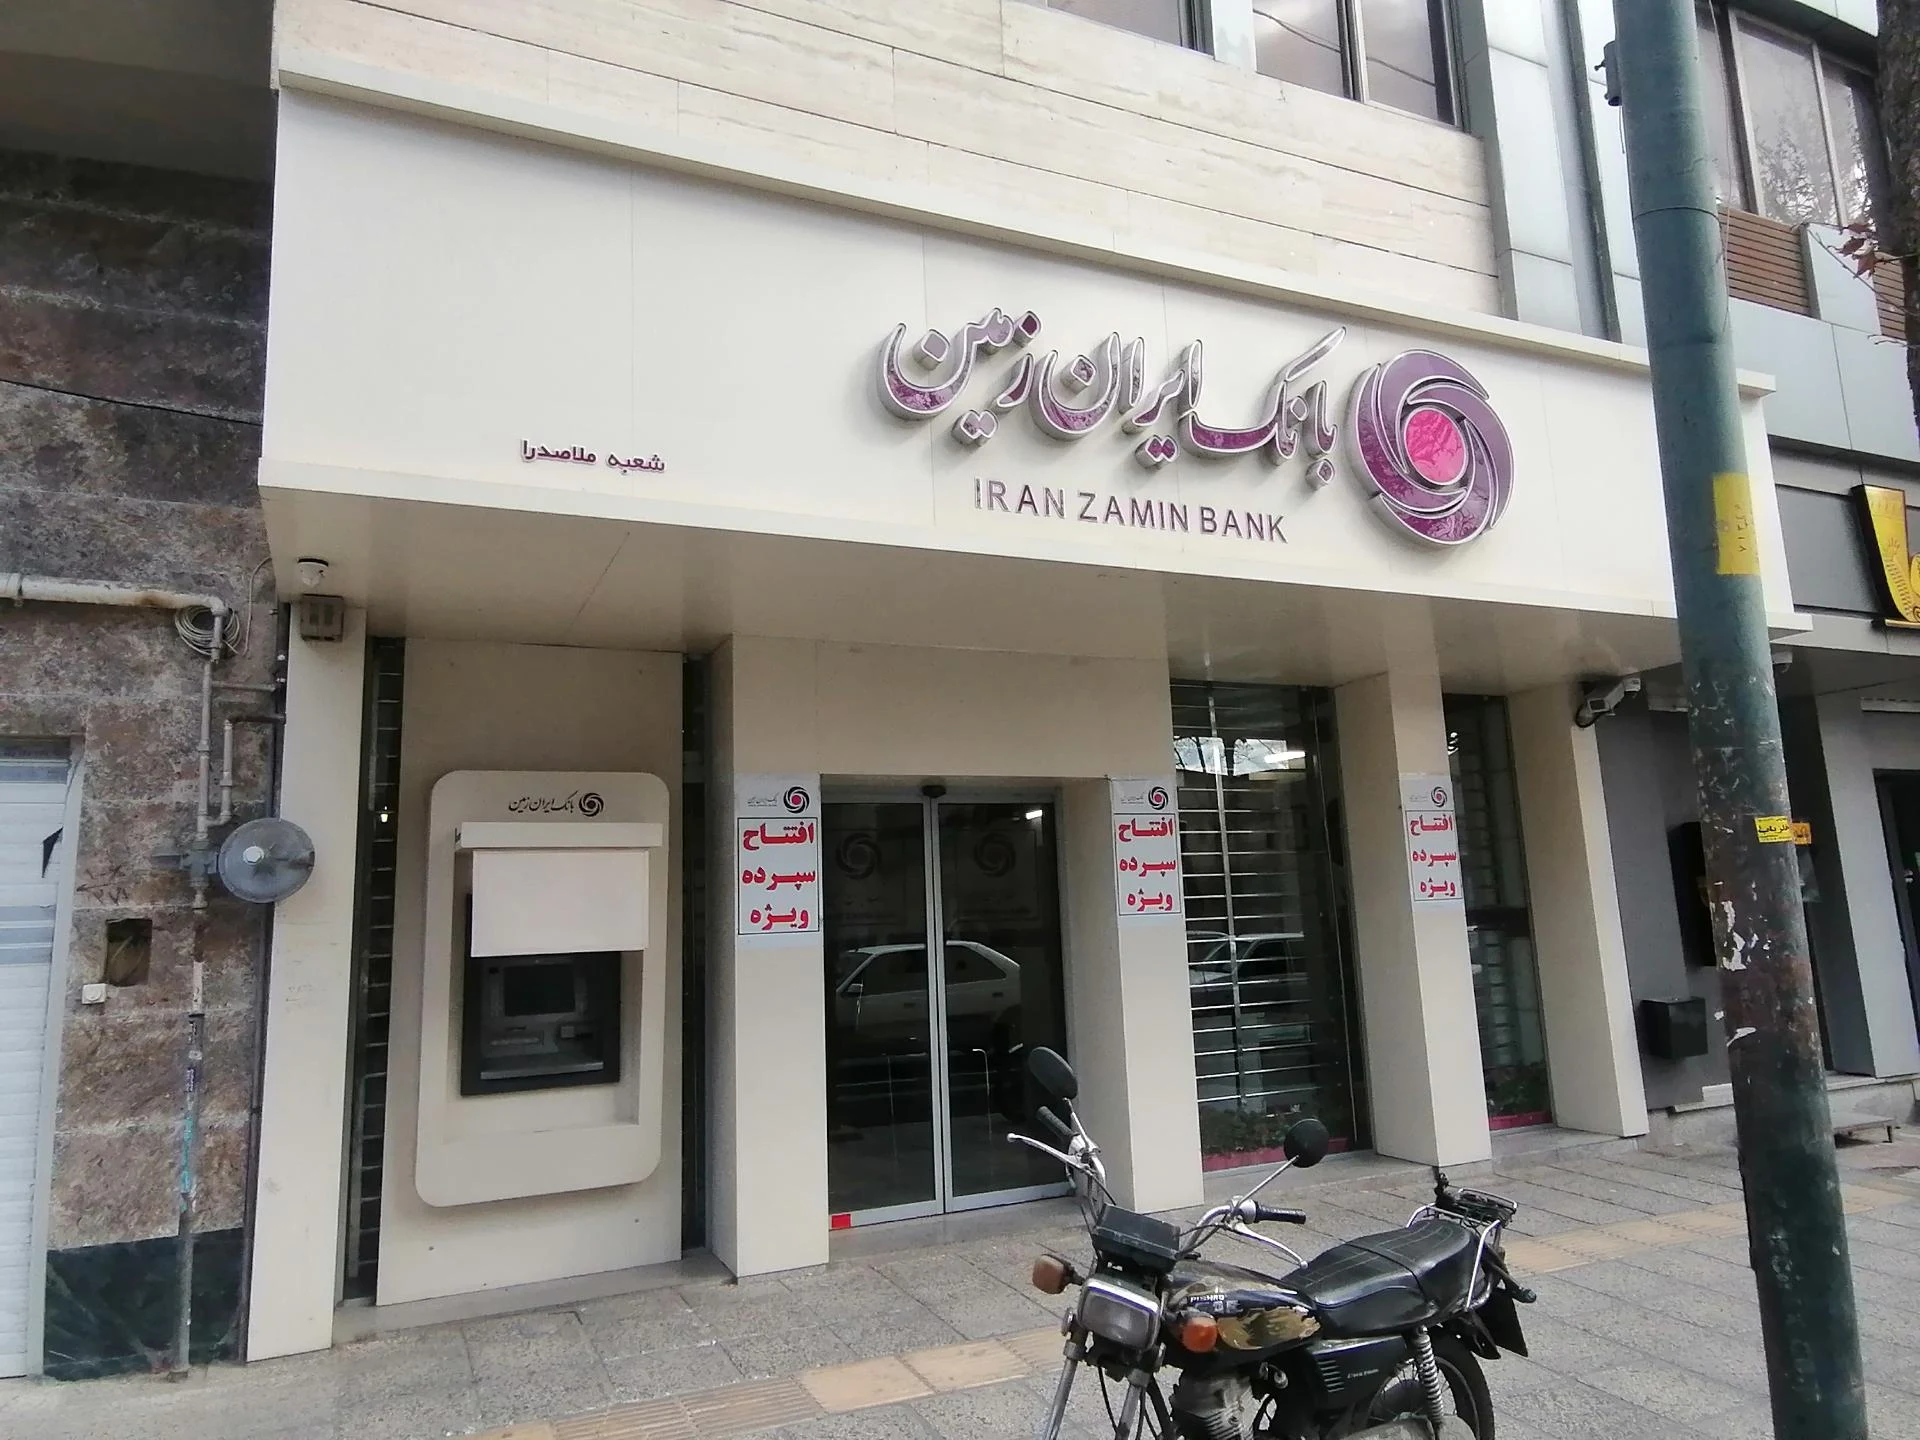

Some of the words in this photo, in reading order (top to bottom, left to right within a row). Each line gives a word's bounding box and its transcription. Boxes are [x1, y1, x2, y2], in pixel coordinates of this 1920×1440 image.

[878, 307, 1041, 446] زمین
[1034, 331, 1202, 468] ایران
[1178, 326, 1346, 490] بانک
[522, 439, 597, 463] ملاصدرا
[608, 453, 666, 475] شعبه
[974, 477, 1066, 519] IRAN
[1077, 490, 1190, 533] ZAMIN
[1200, 505, 1288, 544] BANK
[508, 796, 531, 813] زمین
[528, 798, 556, 813] ایران
[551, 790, 579, 813] بانک
[743, 821, 815, 851] افتتاح
[1118, 816, 1174, 842] افتتاح
[1410, 814, 1453, 836] افتتاح
[1119, 856, 1177, 877] سپرده
[1412, 848, 1457, 868] سپرده
[742, 866, 816, 891] سپرده
[1420, 877, 1456, 898] ویژه
[1127, 888, 1173, 912] ویژه
[750, 903, 810, 931] ویژه
